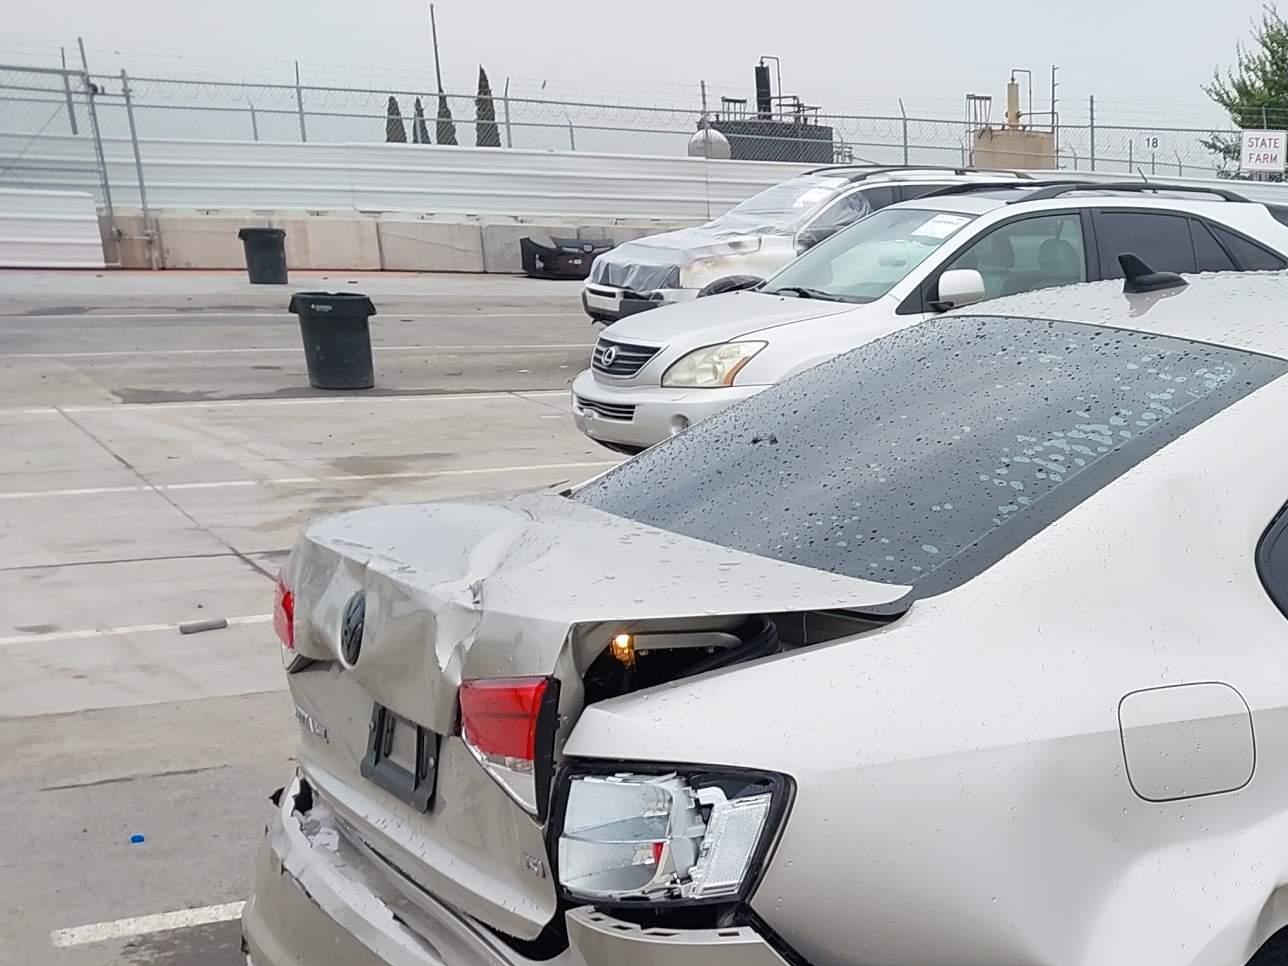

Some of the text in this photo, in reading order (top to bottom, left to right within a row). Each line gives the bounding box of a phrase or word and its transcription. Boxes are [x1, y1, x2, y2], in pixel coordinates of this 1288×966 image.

[1144, 137, 1159, 148] 18
[1248, 136, 1280, 149] STATE
[1249, 152, 1278, 164] FARM
